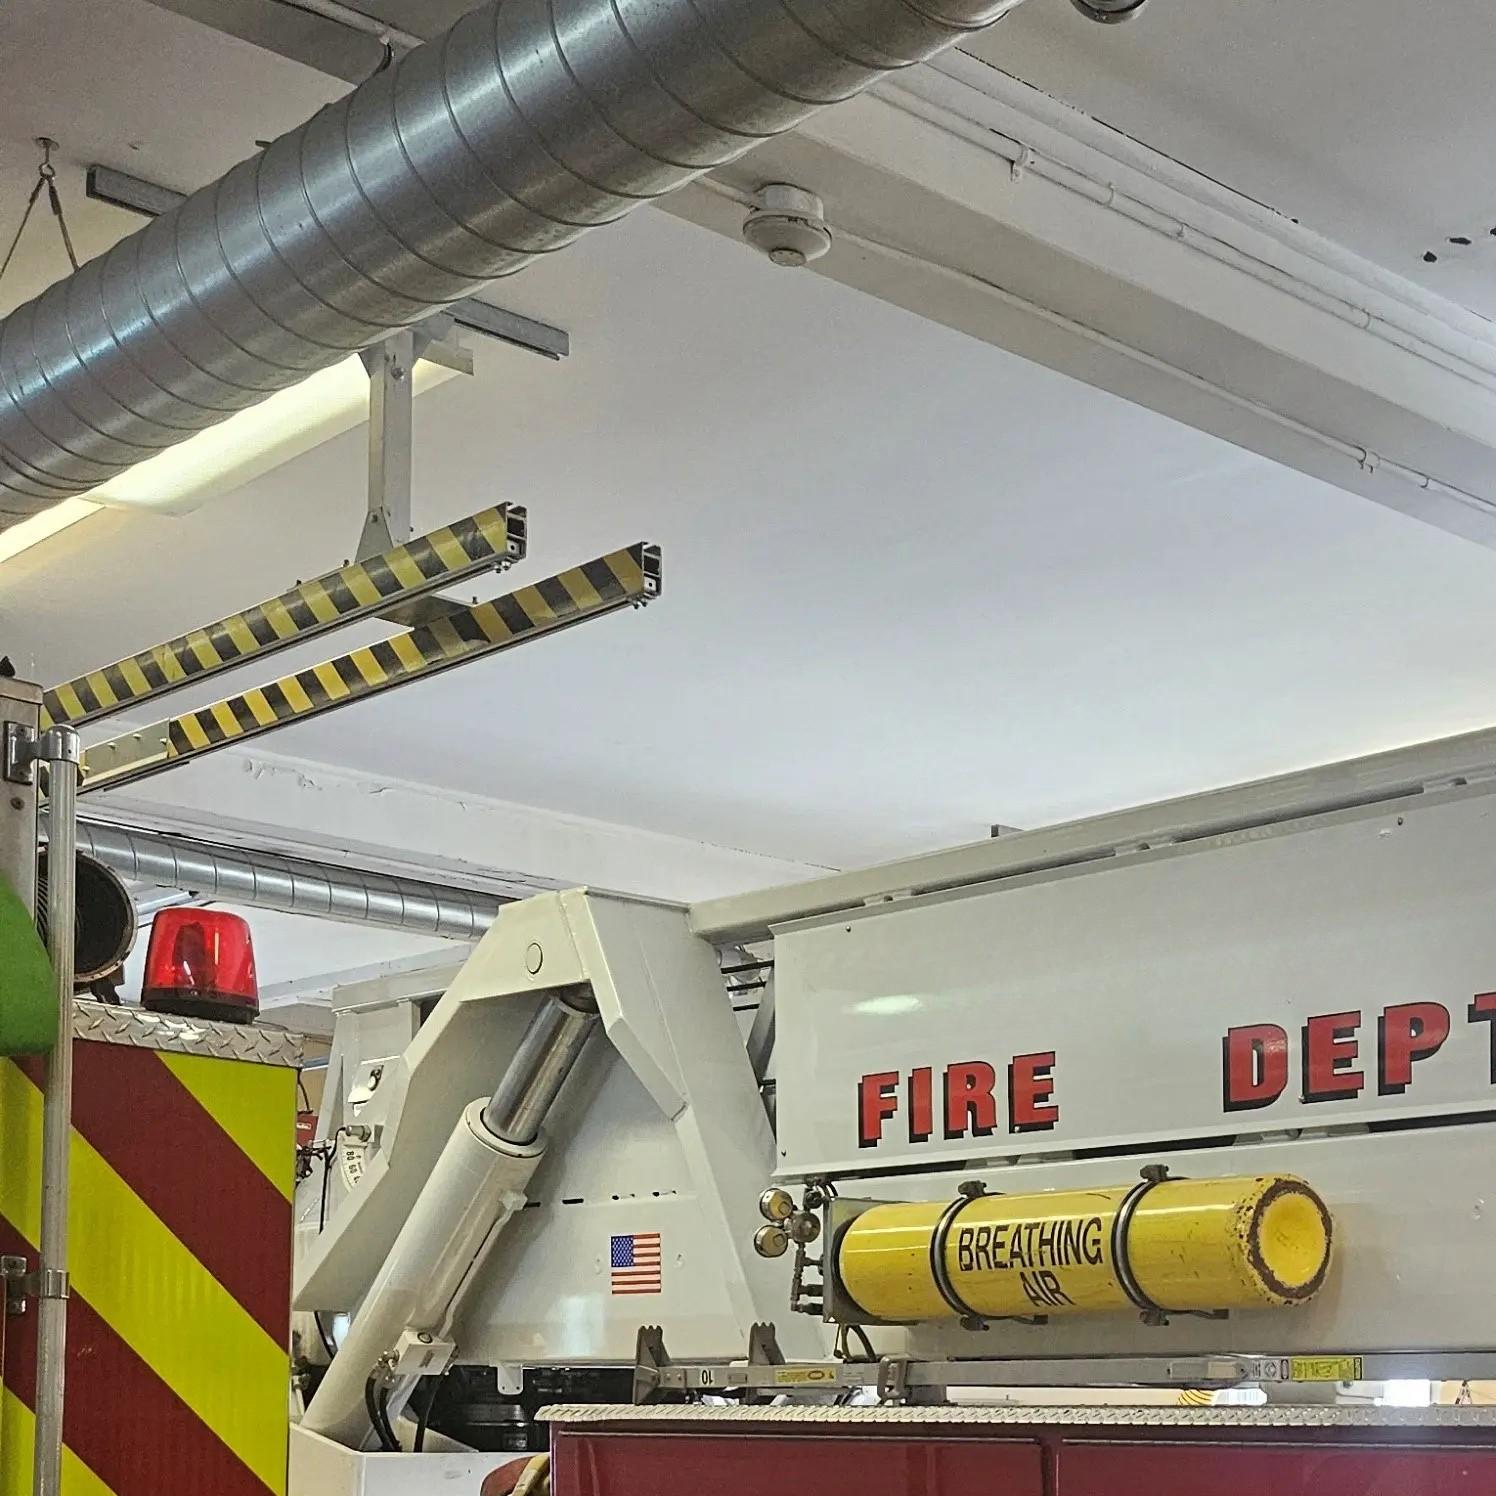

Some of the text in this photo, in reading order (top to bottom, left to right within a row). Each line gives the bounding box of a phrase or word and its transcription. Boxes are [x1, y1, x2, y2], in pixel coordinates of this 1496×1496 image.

[858, 1051, 1059, 1148] FIRE
[958, 1217, 1103, 1272] BREATHING
[1020, 1270, 1077, 1307] AIR
